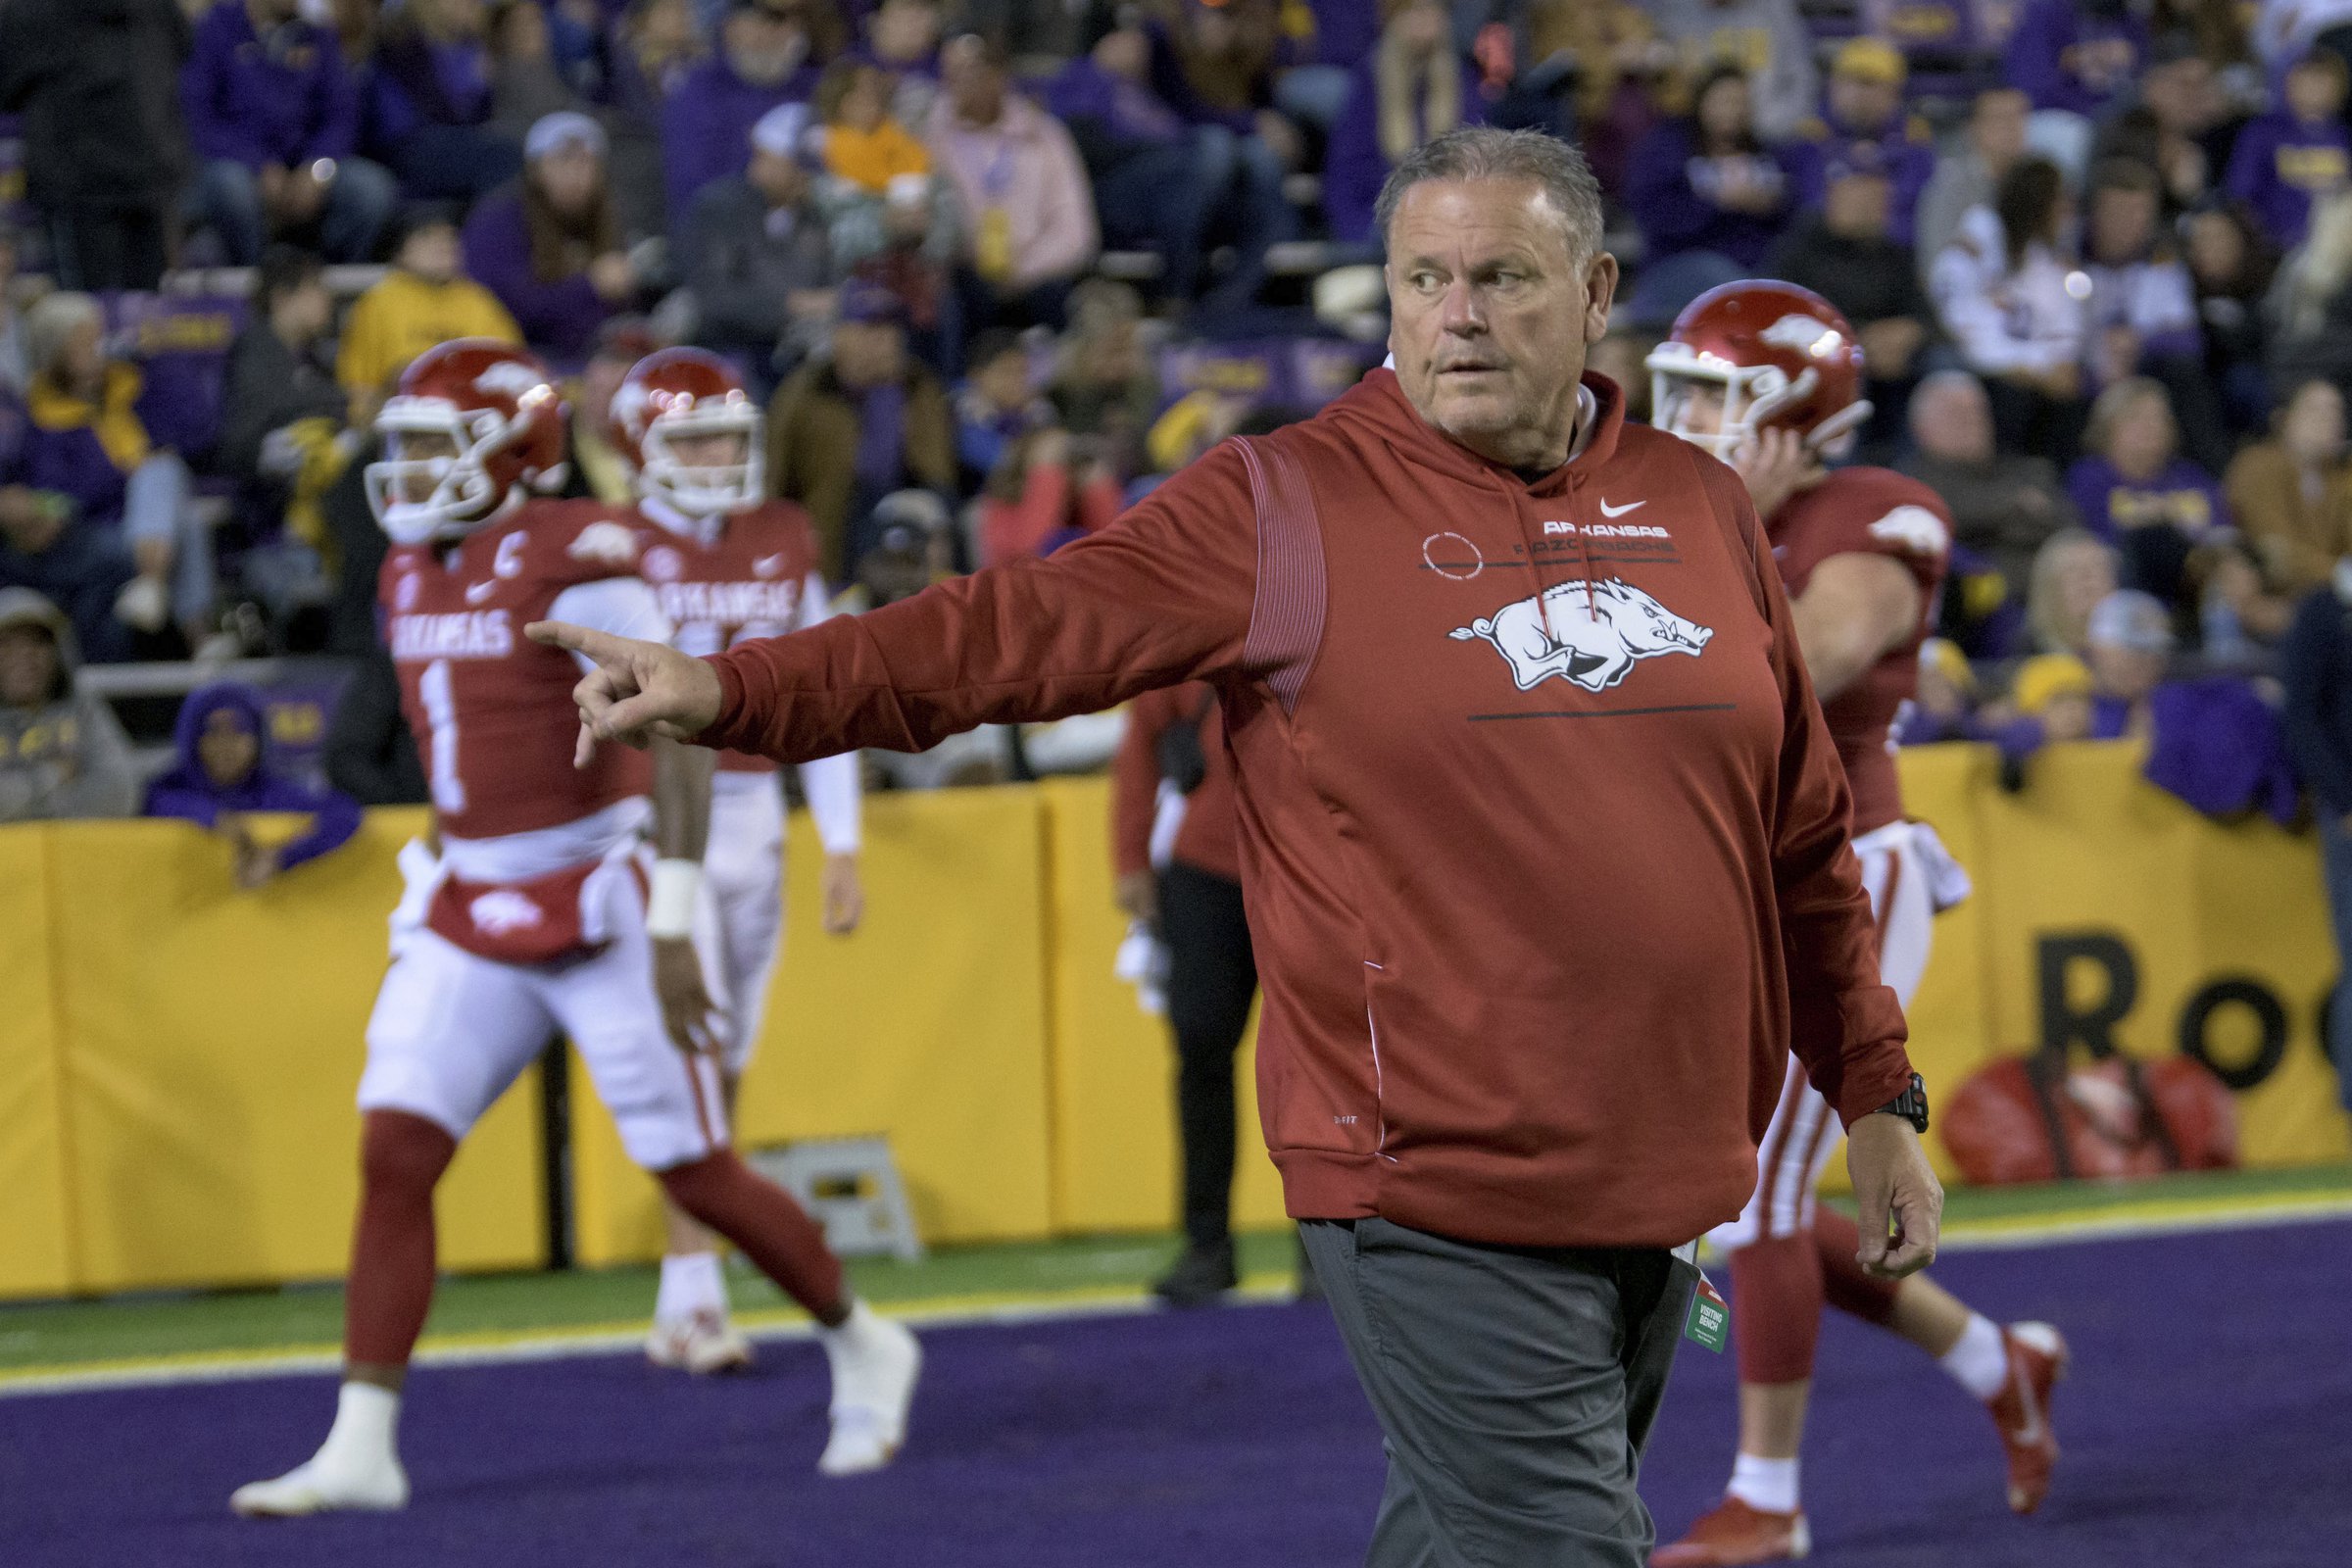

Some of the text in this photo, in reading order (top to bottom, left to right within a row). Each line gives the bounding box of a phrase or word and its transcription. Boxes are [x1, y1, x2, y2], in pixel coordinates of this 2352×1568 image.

[1544, 520, 1671, 538] ARKANSAS
[418, 658, 466, 814] 1
[1699, 1314, 1719, 1333] BENCH
[1700, 1303, 1723, 1324] VISITING
